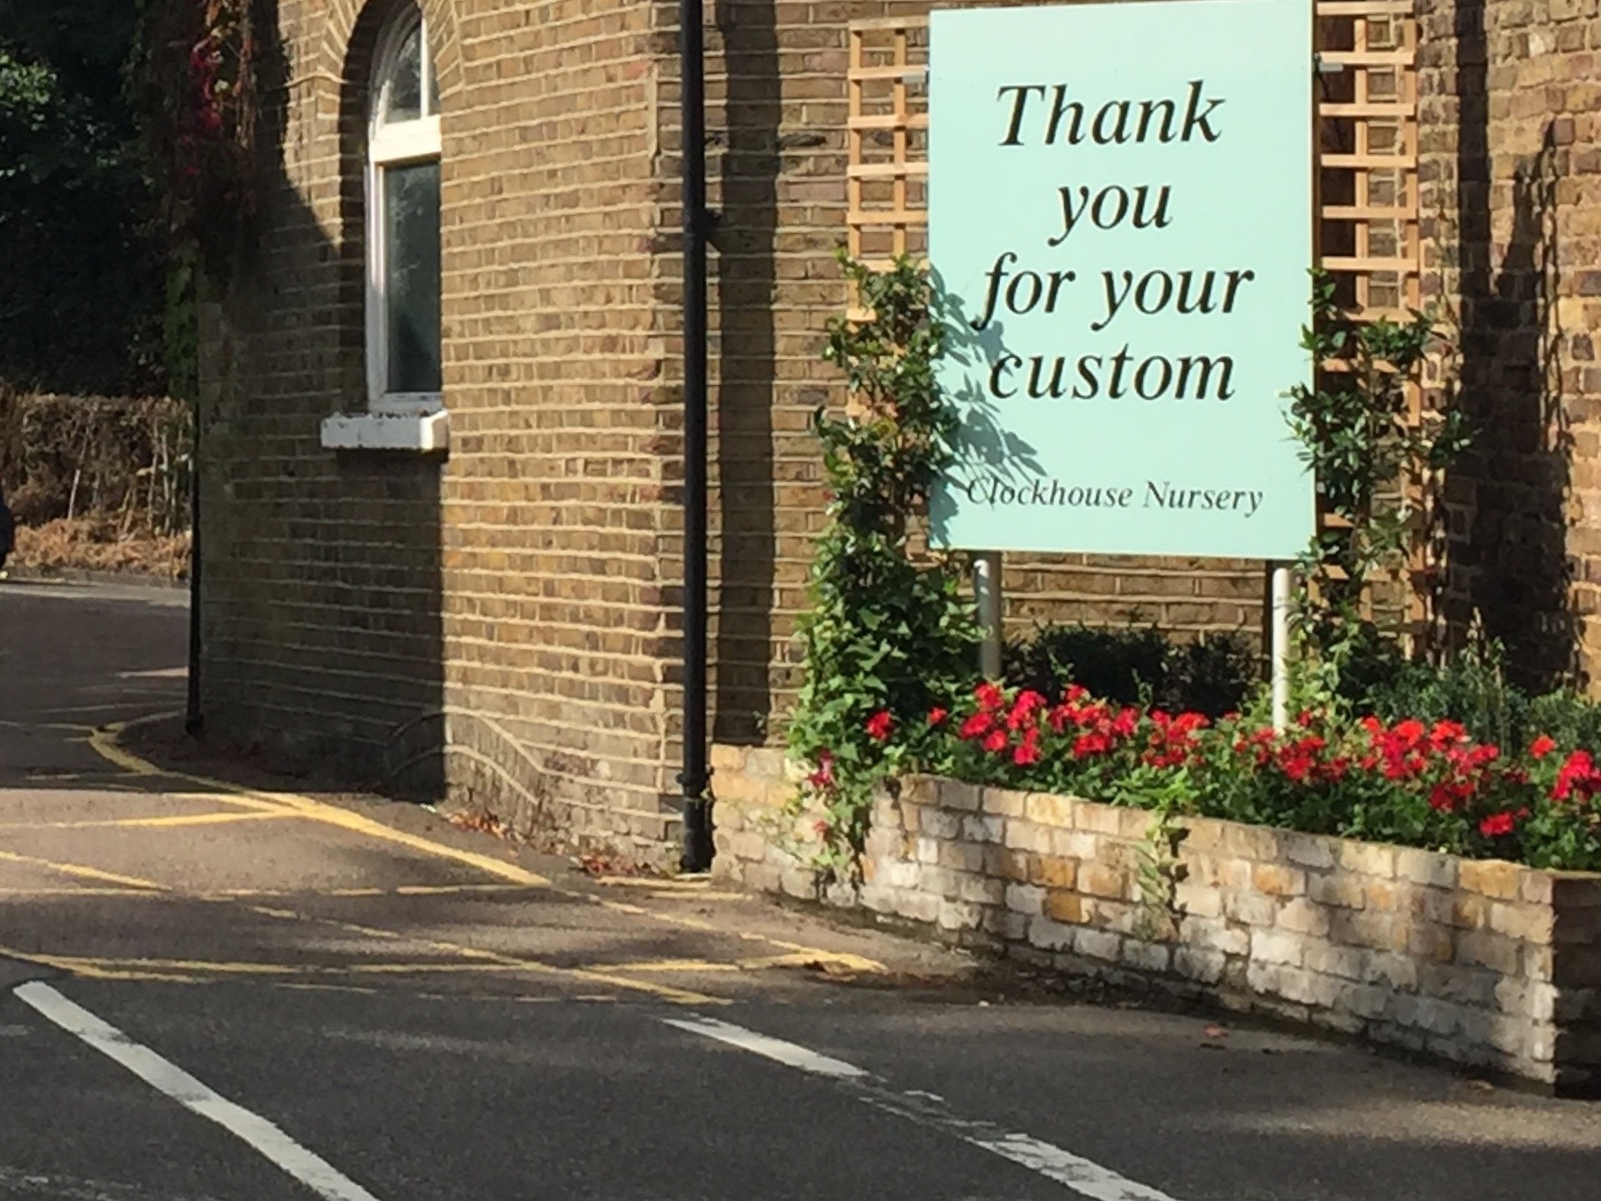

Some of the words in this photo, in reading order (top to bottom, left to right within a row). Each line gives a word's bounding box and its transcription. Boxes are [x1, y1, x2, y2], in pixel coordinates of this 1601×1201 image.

[996, 79, 1226, 147] Thank
[1048, 183, 1173, 248] you
[971, 251, 1076, 331] for
[1091, 269, 1255, 331] your
[988, 342, 1236, 401] custom
[966, 476, 1133, 508] Clockhouse
[1143, 480, 1264, 518] Nursery
